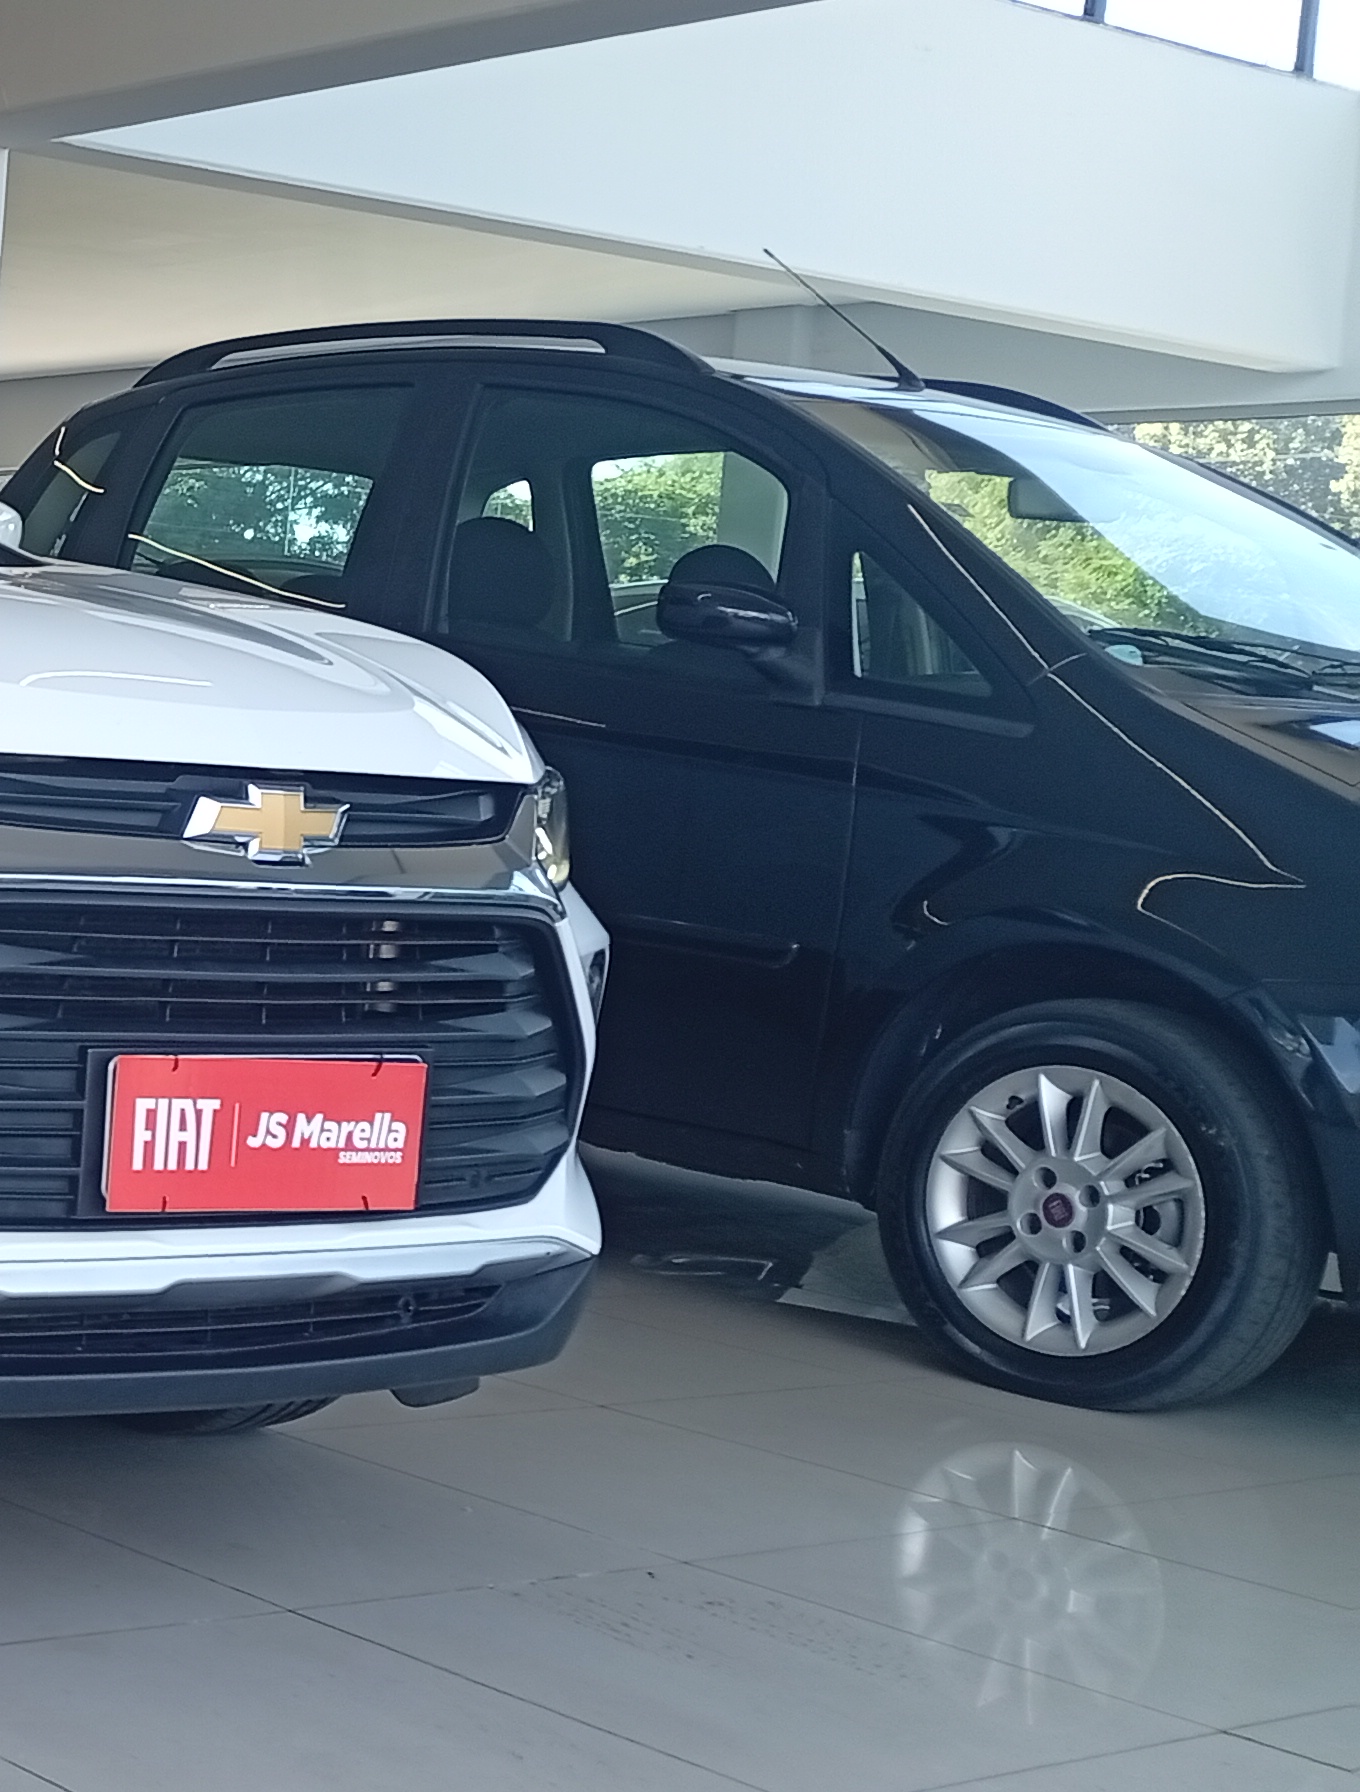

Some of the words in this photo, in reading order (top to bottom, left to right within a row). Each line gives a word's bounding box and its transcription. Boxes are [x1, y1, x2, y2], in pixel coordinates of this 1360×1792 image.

[131, 1097, 221, 1171] FIAT
[246, 1112, 289, 1148] JS
[291, 1112, 407, 1149] Marella
[337, 1151, 403, 1164] SEMINOVOS
